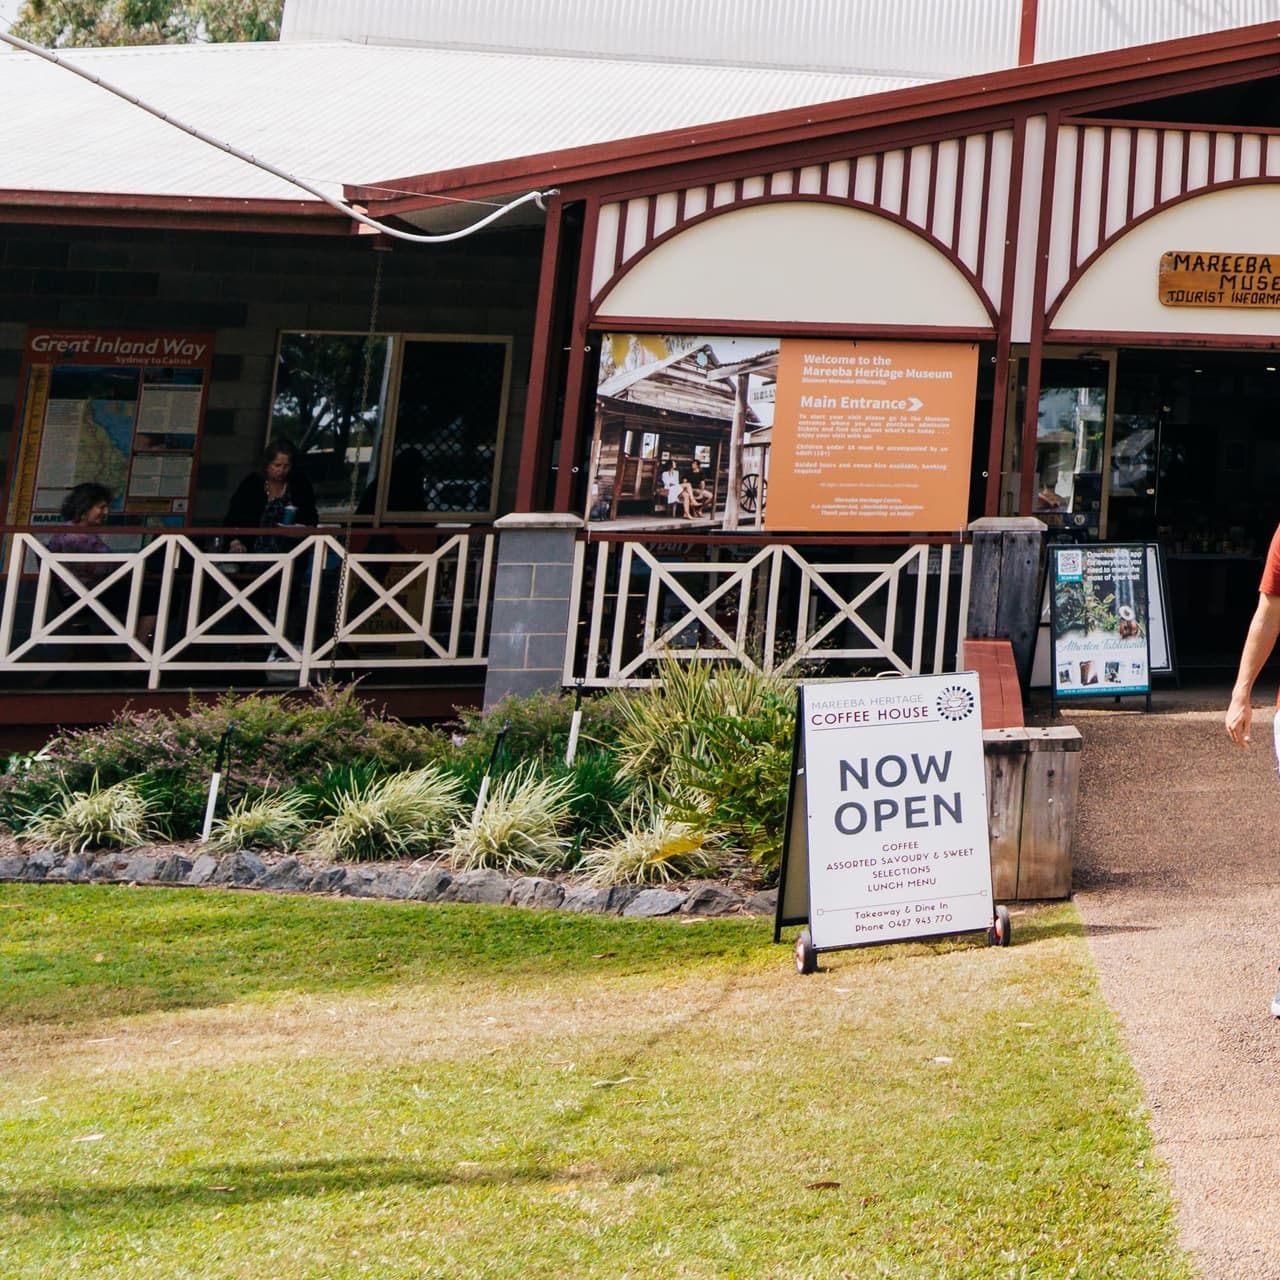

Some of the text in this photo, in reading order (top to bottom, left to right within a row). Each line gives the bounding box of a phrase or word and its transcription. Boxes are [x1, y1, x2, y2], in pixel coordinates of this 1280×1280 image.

[1173, 254, 1272, 274] MAREEBA
[1167, 290, 1224, 304] TOURIST
[31, 335, 207, 360] Great Inland Way
[116, 355, 192, 365] Sydney to Cairns
[804, 354, 892, 366] Welcome to the
[803, 366, 953, 380] Mareeba Heritage Museum
[800, 395, 907, 410] Main Entrance
[811, 694, 924, 710] MAREEBA HERITAGE
[811, 706, 929, 726] COFFEE HOUSE
[839, 750, 953, 792] NOW
[834, 792, 963, 835] OPEN
[882, 841, 919, 852] COFFEE
[826, 848, 974, 871] ASSORTED SAVOURY & SWEET
[872, 865, 931, 879] SELECTIONS
[867, 877, 936, 892] LUNCH MENU
[855, 908, 900, 919] Takeaway
[915, 904, 936, 913] Dine
[939, 902, 949, 910] In
[855, 923, 884, 932] Phone
[888, 917, 911, 929] 0427
[935, 913, 953, 923] 770
